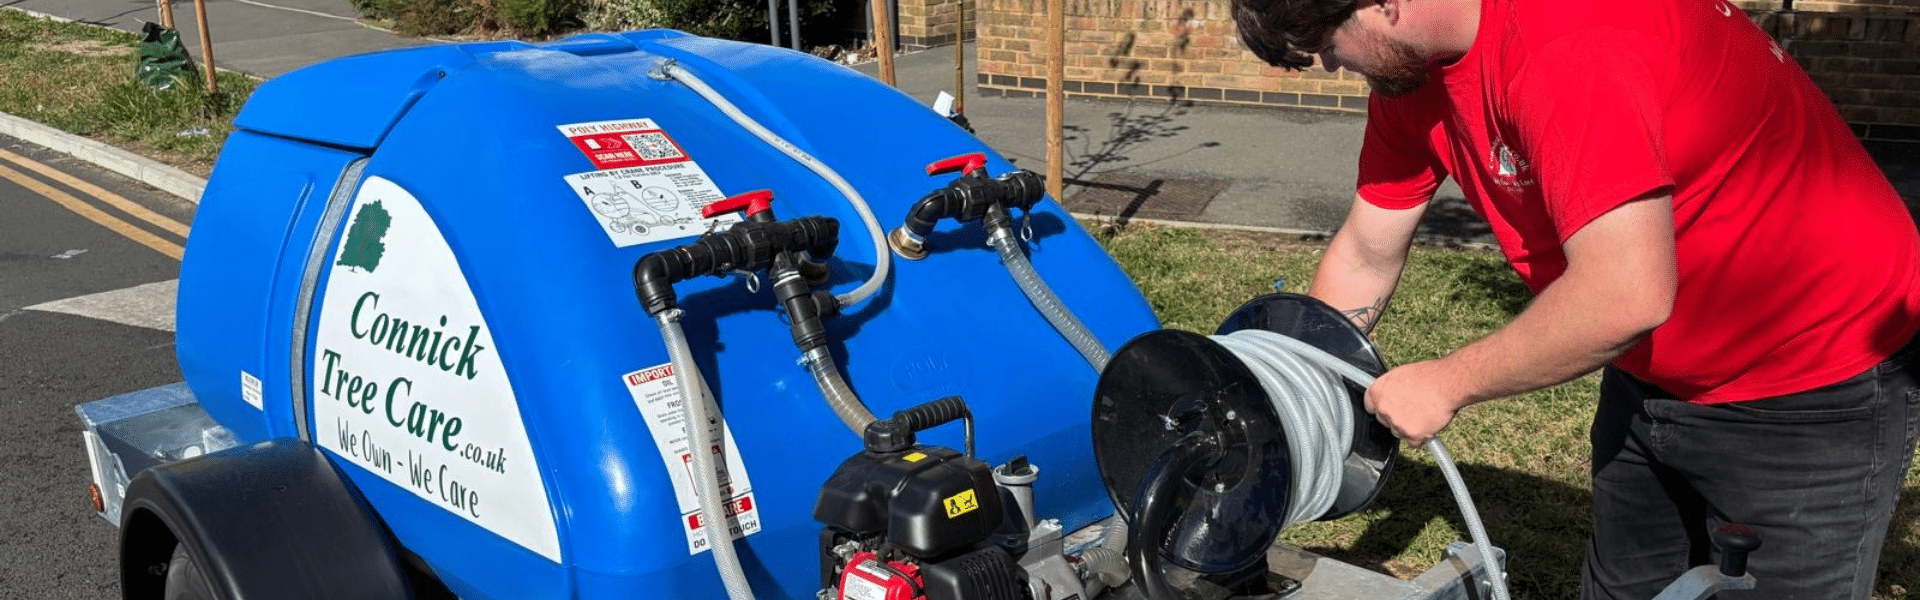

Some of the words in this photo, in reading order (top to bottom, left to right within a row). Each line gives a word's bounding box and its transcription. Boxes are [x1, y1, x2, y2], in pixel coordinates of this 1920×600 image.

[568, 125, 597, 135] POLY
[599, 121, 649, 132] HIGHWAY
[579, 171, 609, 180] LIFTING
[620, 167, 643, 175] CRANE
[645, 163, 686, 172] PROCEDURE
[582, 186, 596, 197] A
[630, 179, 643, 189] B
[350, 291, 485, 380] Connick
[320, 348, 378, 414] Tree
[631, 365, 674, 385] IMPORT
[336, 416, 359, 457] We
[362, 430, 392, 474] Own
[408, 449, 433, 494] We
[438, 464, 480, 518] Care
[729, 520, 757, 536] TOUCH
[694, 538, 706, 549] DO
